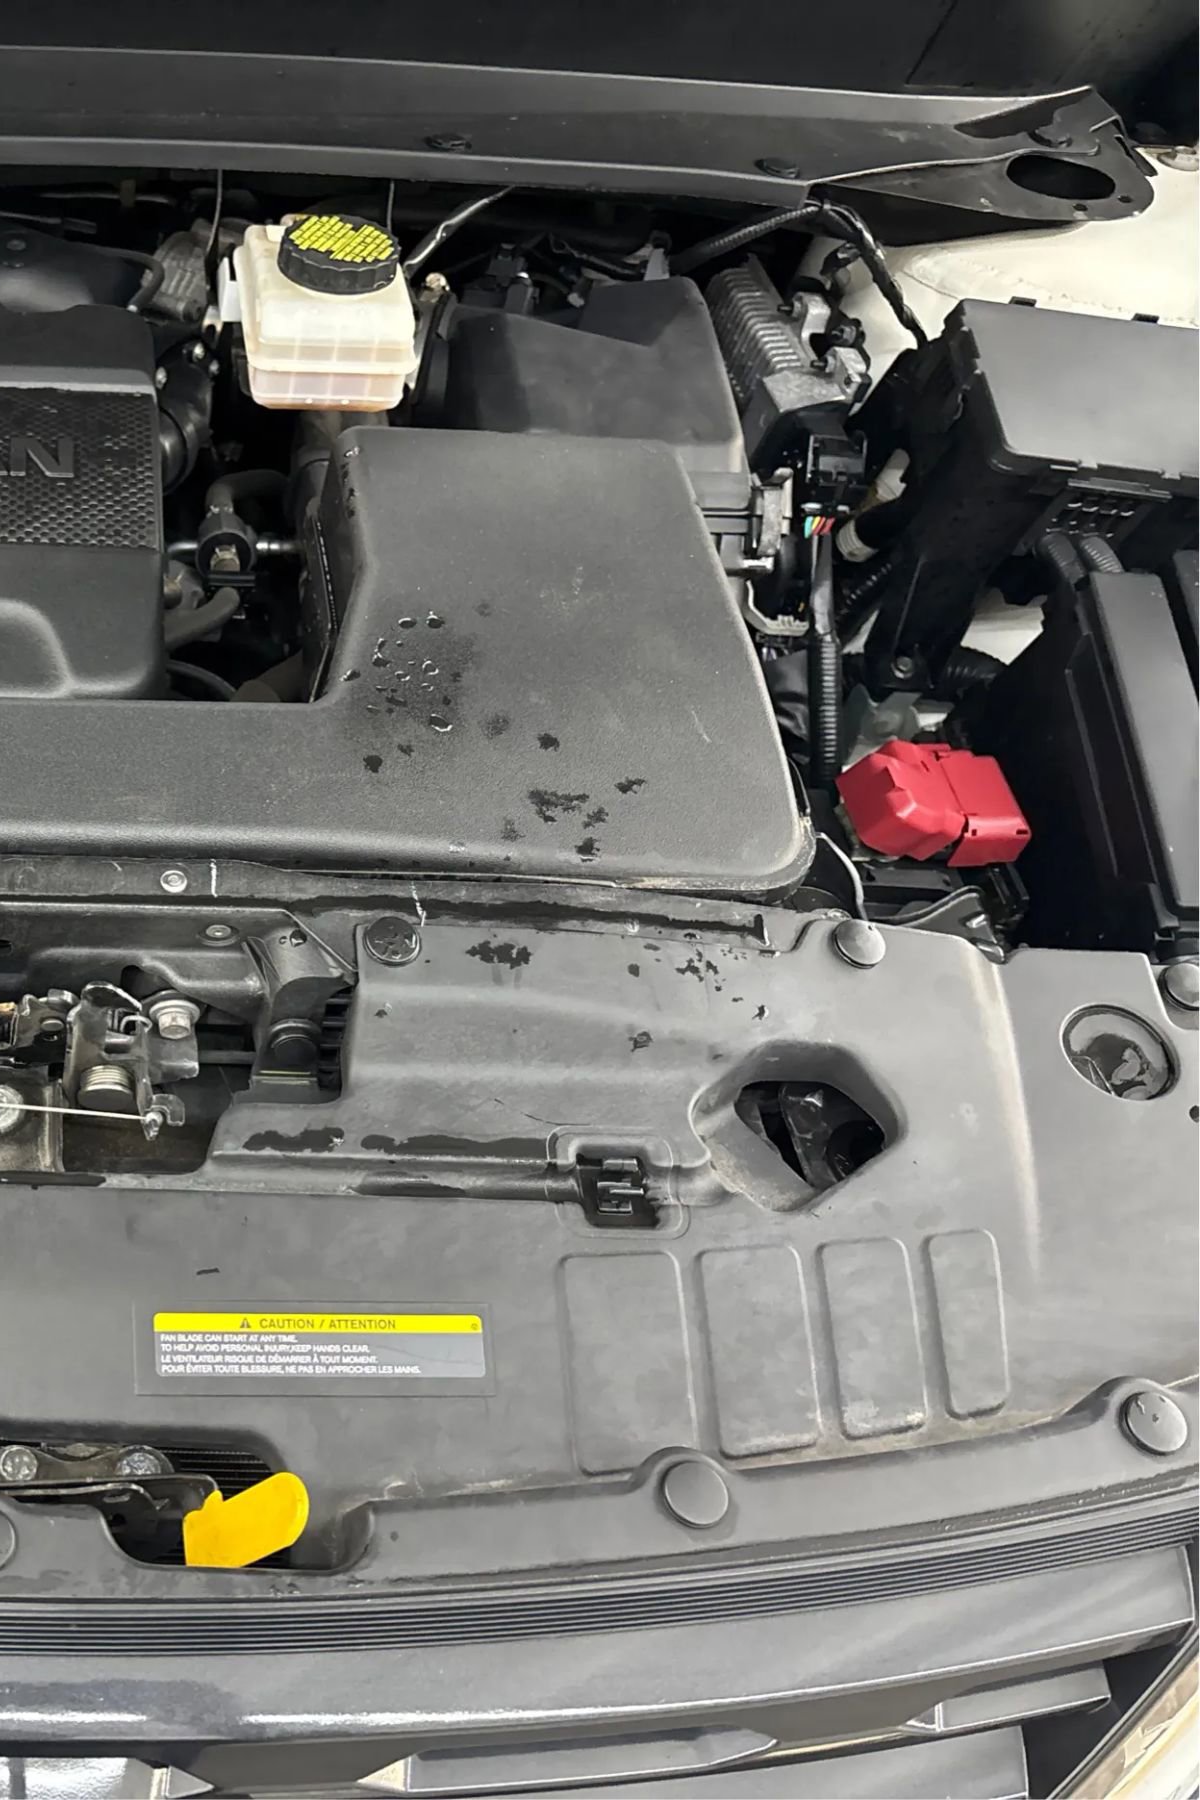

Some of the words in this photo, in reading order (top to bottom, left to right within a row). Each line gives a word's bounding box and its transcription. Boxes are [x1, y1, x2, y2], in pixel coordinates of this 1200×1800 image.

[259, 1318, 314, 1329] CAUTION
[319, 1318, 326, 1329] /
[329, 1319, 396, 1329] ATTENTION
[160, 1334, 176, 1342] FAN
[177, 1334, 204, 1342] BLADE
[204, 1334, 222, 1342] CAN
[223, 1334, 248, 1342] START
[249, 1334, 258, 1342] AT
[277, 1335, 298, 1343] TIME.
[161, 1344, 172, 1352] TO
[173, 1344, 195, 1352] HELP
[195, 1344, 220, 1352] AVOID
[221, 1344, 263, 1352] PERSONAL
[313, 1344, 341, 1352] HANDS
[342, 1345, 370, 1353] CLEAR.
[161, 1355, 171, 1363] LE
[172, 1355, 223, 1363] VENTILATEUR
[224, 1355, 254, 1363] RISQUE
[255, 1355, 267, 1363] DE
[268, 1353, 312, 1363] DÉMARRER
[312, 1353, 319, 1363] À
[320, 1355, 341, 1364] TOUT
[161, 1364, 185, 1373] POUR
[186, 1363, 213, 1373] ÉVITER
[214, 1365, 240, 1373] TOUTE
[285, 1365, 297, 1373] NE
[298, 1365, 314, 1373] PAS
[315, 1365, 328, 1373] EN
[328, 1365, 377, 1374] APPROCHER
[378, 1365, 394, 1374] LES
